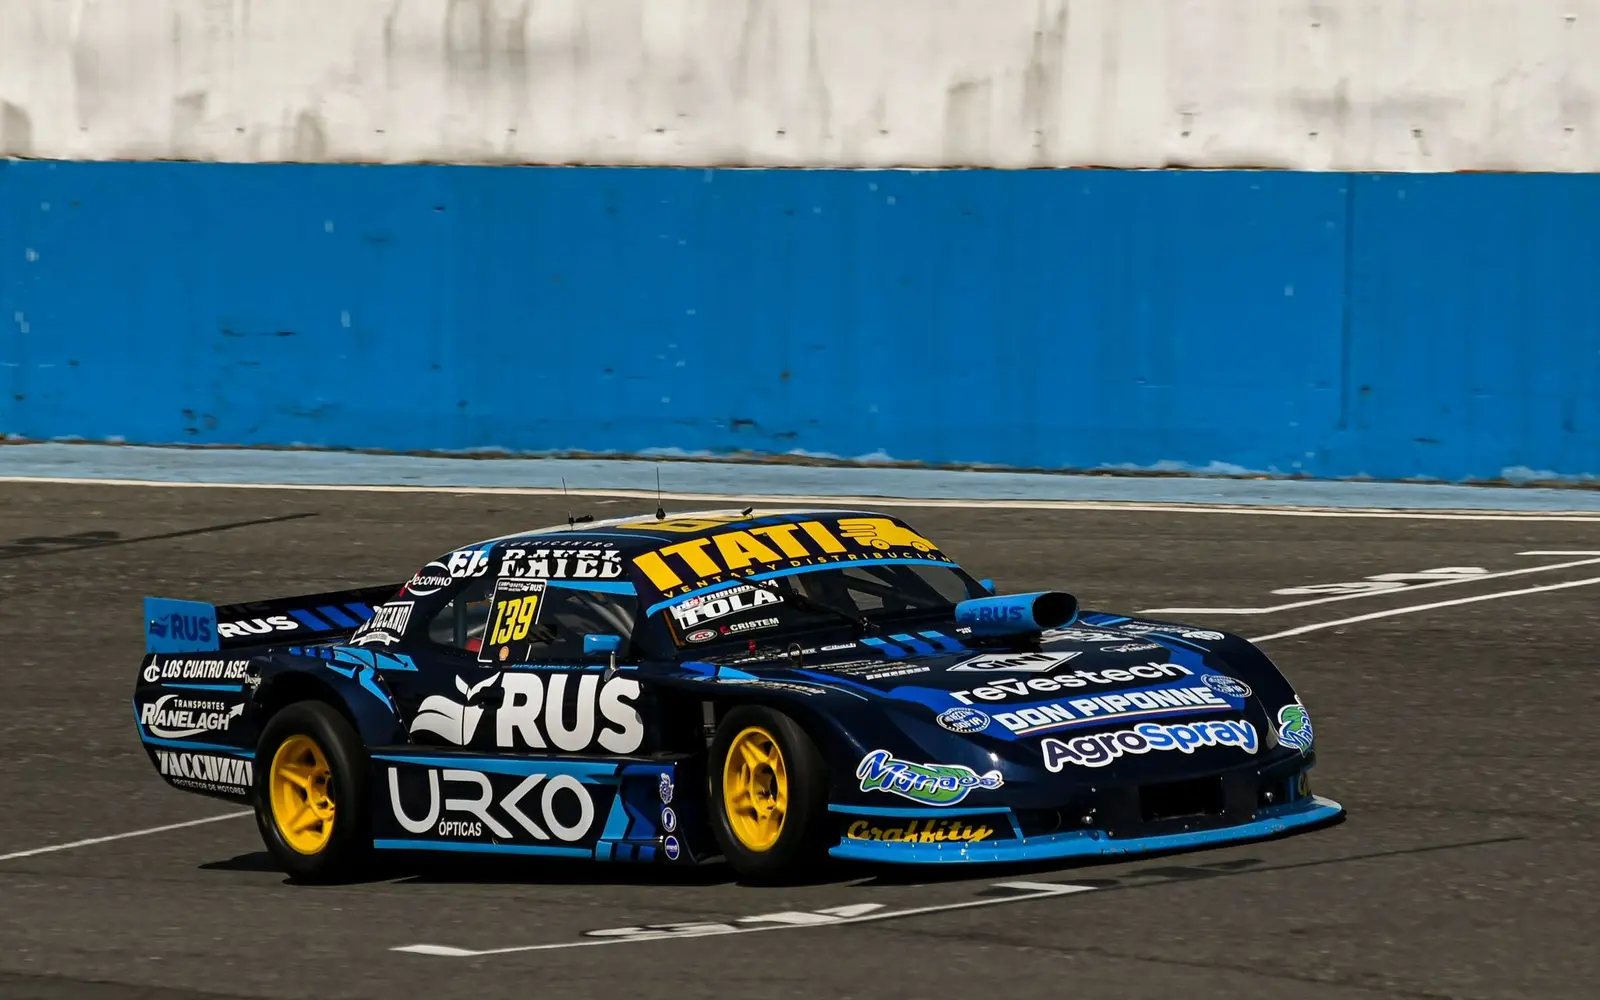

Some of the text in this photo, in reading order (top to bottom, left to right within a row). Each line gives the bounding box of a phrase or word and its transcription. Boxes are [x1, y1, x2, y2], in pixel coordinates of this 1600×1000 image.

[633, 521, 847, 592] ITATI
[766, 563, 777, 571] Y
[791, 550, 951, 567] DISTRIBUCIÓN
[529, 583, 543, 592] RUS
[677, 579, 780, 609] DISTRIBUIDA
[370, 605, 411, 634] DECANO
[489, 595, 538, 646] 139
[679, 588, 778, 626] TOLA
[979, 606, 1025, 622] RUS
[171, 614, 212, 643] RUS
[217, 616, 298, 639] RUS
[730, 617, 780, 632] CRISTEM
[161, 660, 181, 678] LOS
[182, 660, 222, 679] CUATRO
[949, 662, 1195, 705] revestech
[141, 703, 231, 731] RANELAGH
[173, 699, 225, 712] TRANSPORTES
[496, 672, 645, 754] RUS
[991, 704, 1070, 731] DON
[1070, 687, 1226, 720] PIPONNE
[1042, 720, 1258, 772] AgroSpray
[857, 750, 1000, 793] Manaos
[172, 778, 208, 790] PROTECTOR
[217, 785, 246, 795] MOTORES
[388, 767, 594, 842] URKO
[438, 818, 482, 837] ÓPTICAS
